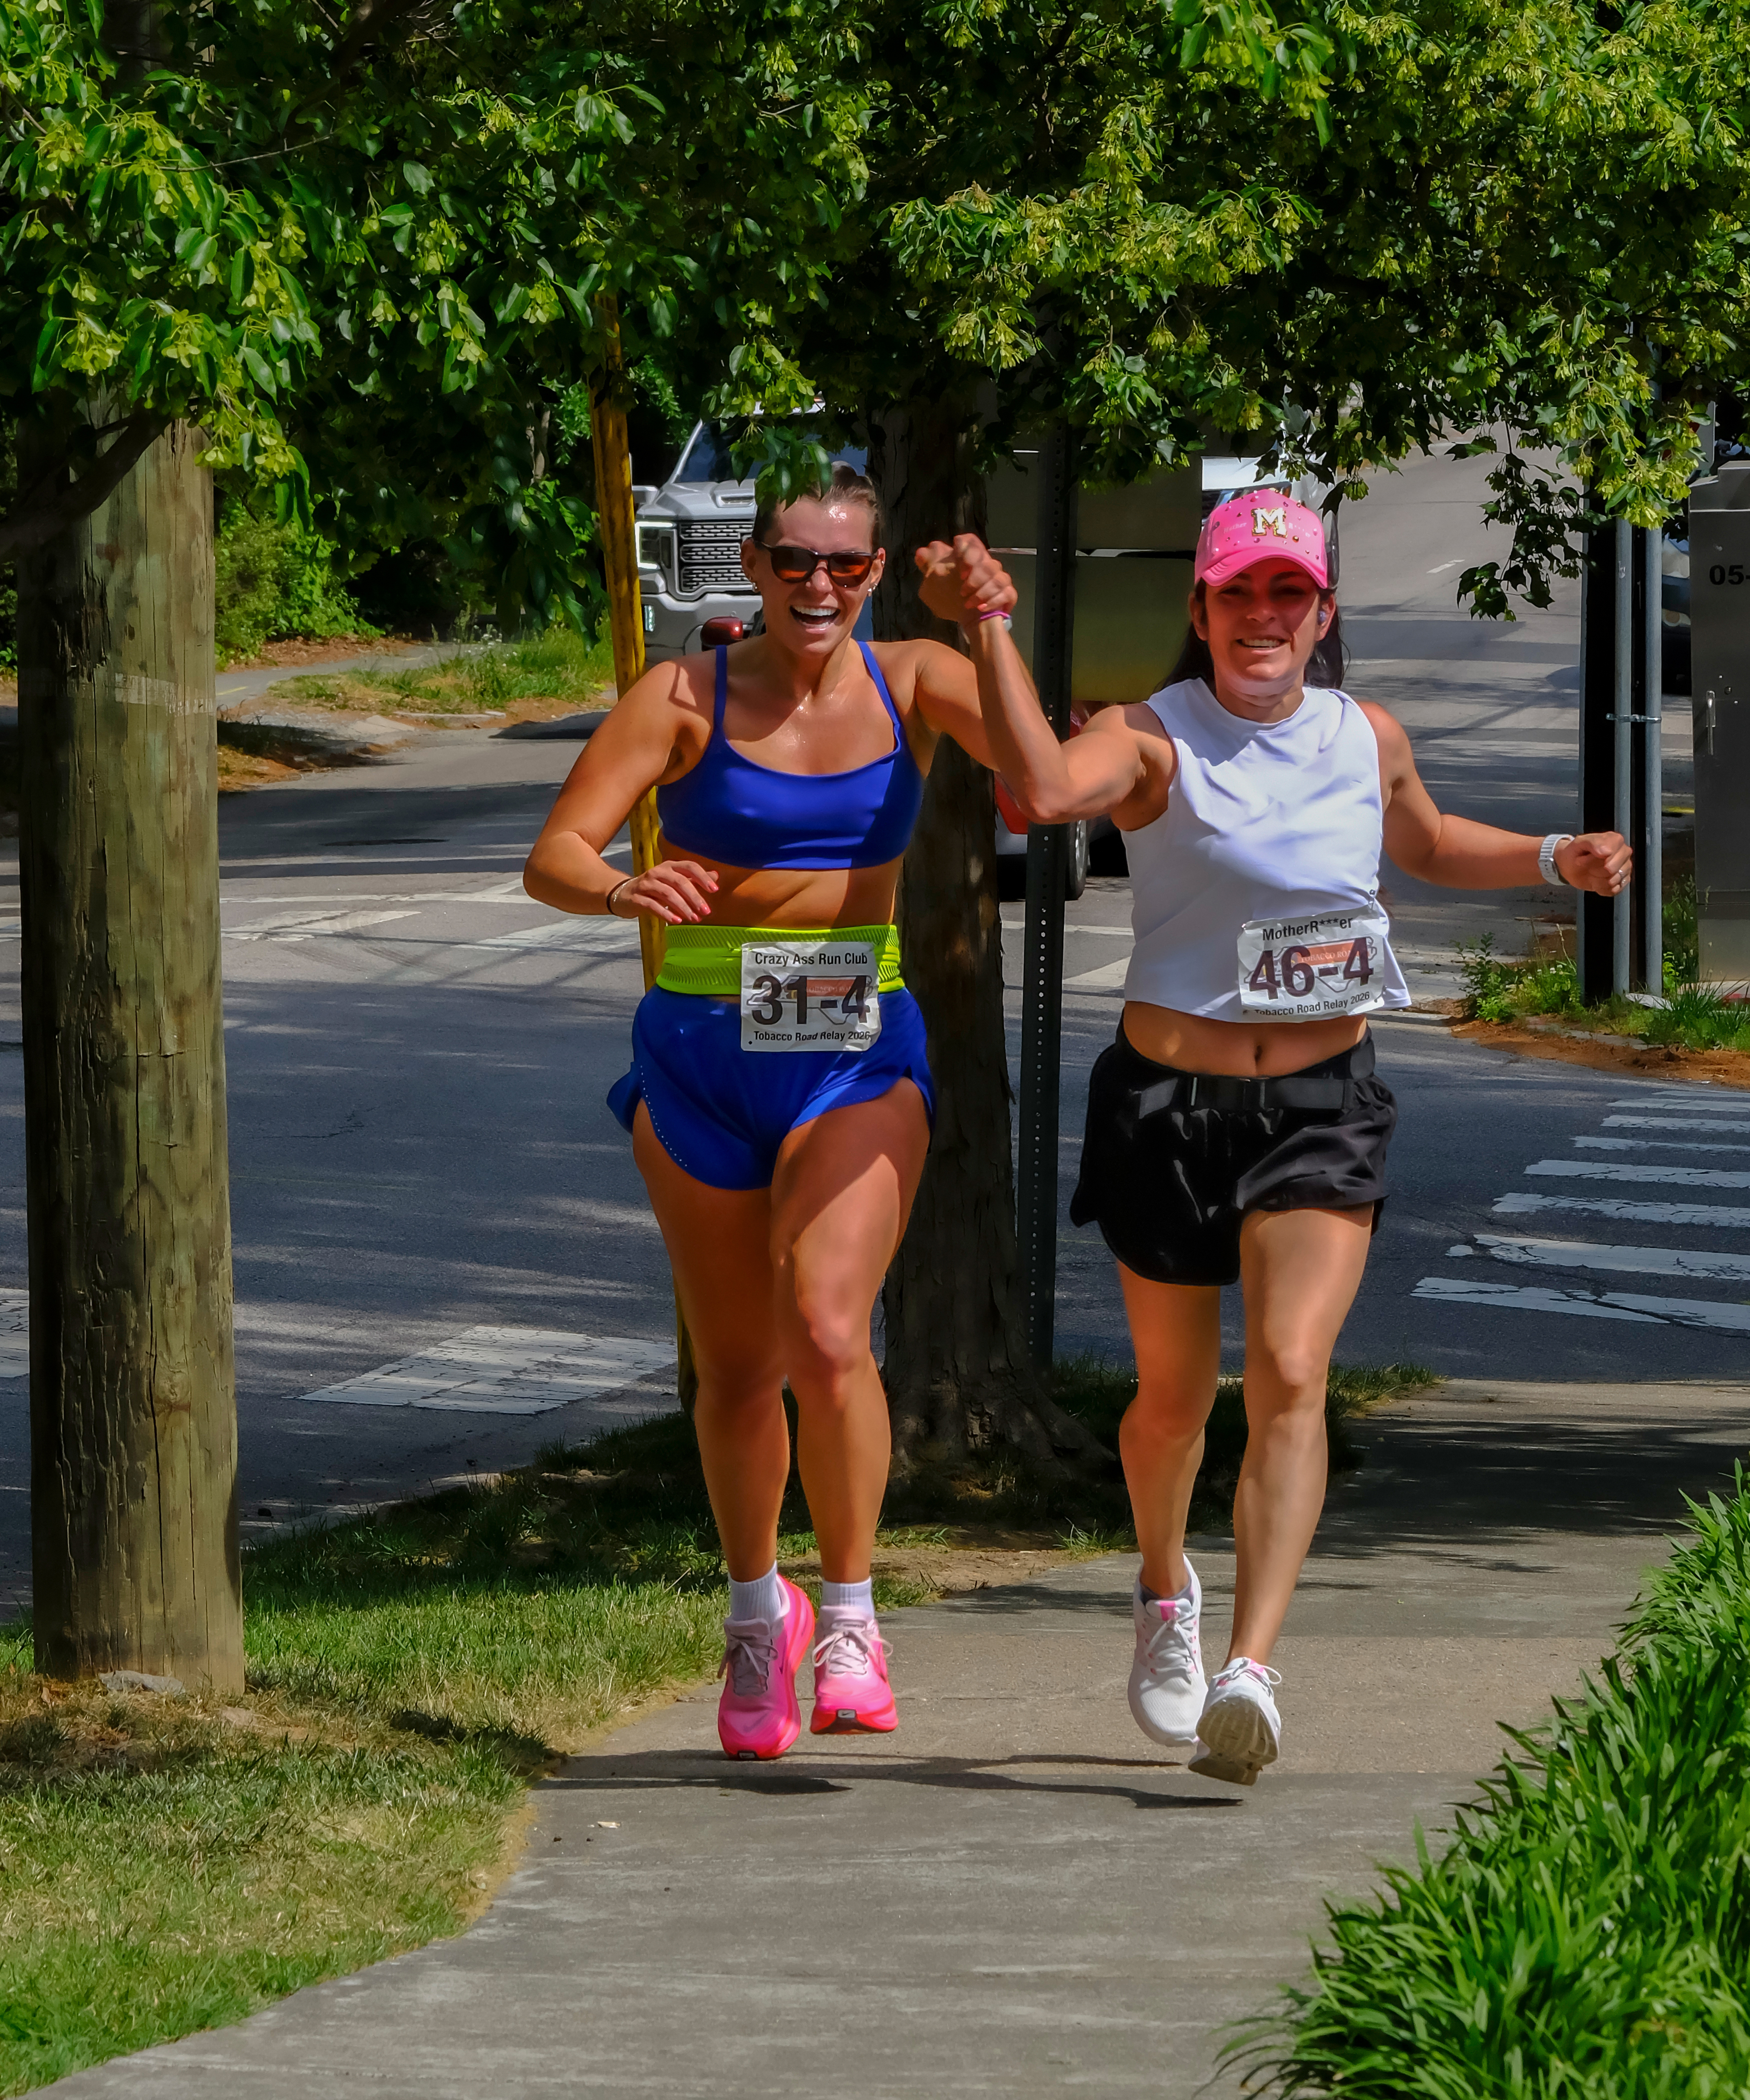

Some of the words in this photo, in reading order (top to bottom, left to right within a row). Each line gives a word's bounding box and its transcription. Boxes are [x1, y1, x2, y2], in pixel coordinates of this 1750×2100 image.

[1251, 507, 1287, 538] M
[755, 953, 789, 966] Crazy
[793, 954, 814, 965] Ass
[819, 954, 841, 965] Run
[845, 953, 868, 964] Club
[1249, 938, 1374, 1000] 46-4
[752, 975, 870, 1025] 31-4
[1255, 1007, 1293, 1016] Tobacco
[1297, 1001, 1320, 1013] Road
[1324, 999, 1348, 1010] Relay
[1351, 992, 1370, 1004] 2026
[754, 1031, 792, 1041] Tobacco
[795, 1032, 818, 1041] Road
[820, 1031, 845, 1042] Relay
[848, 1031, 870, 1041] 2026
